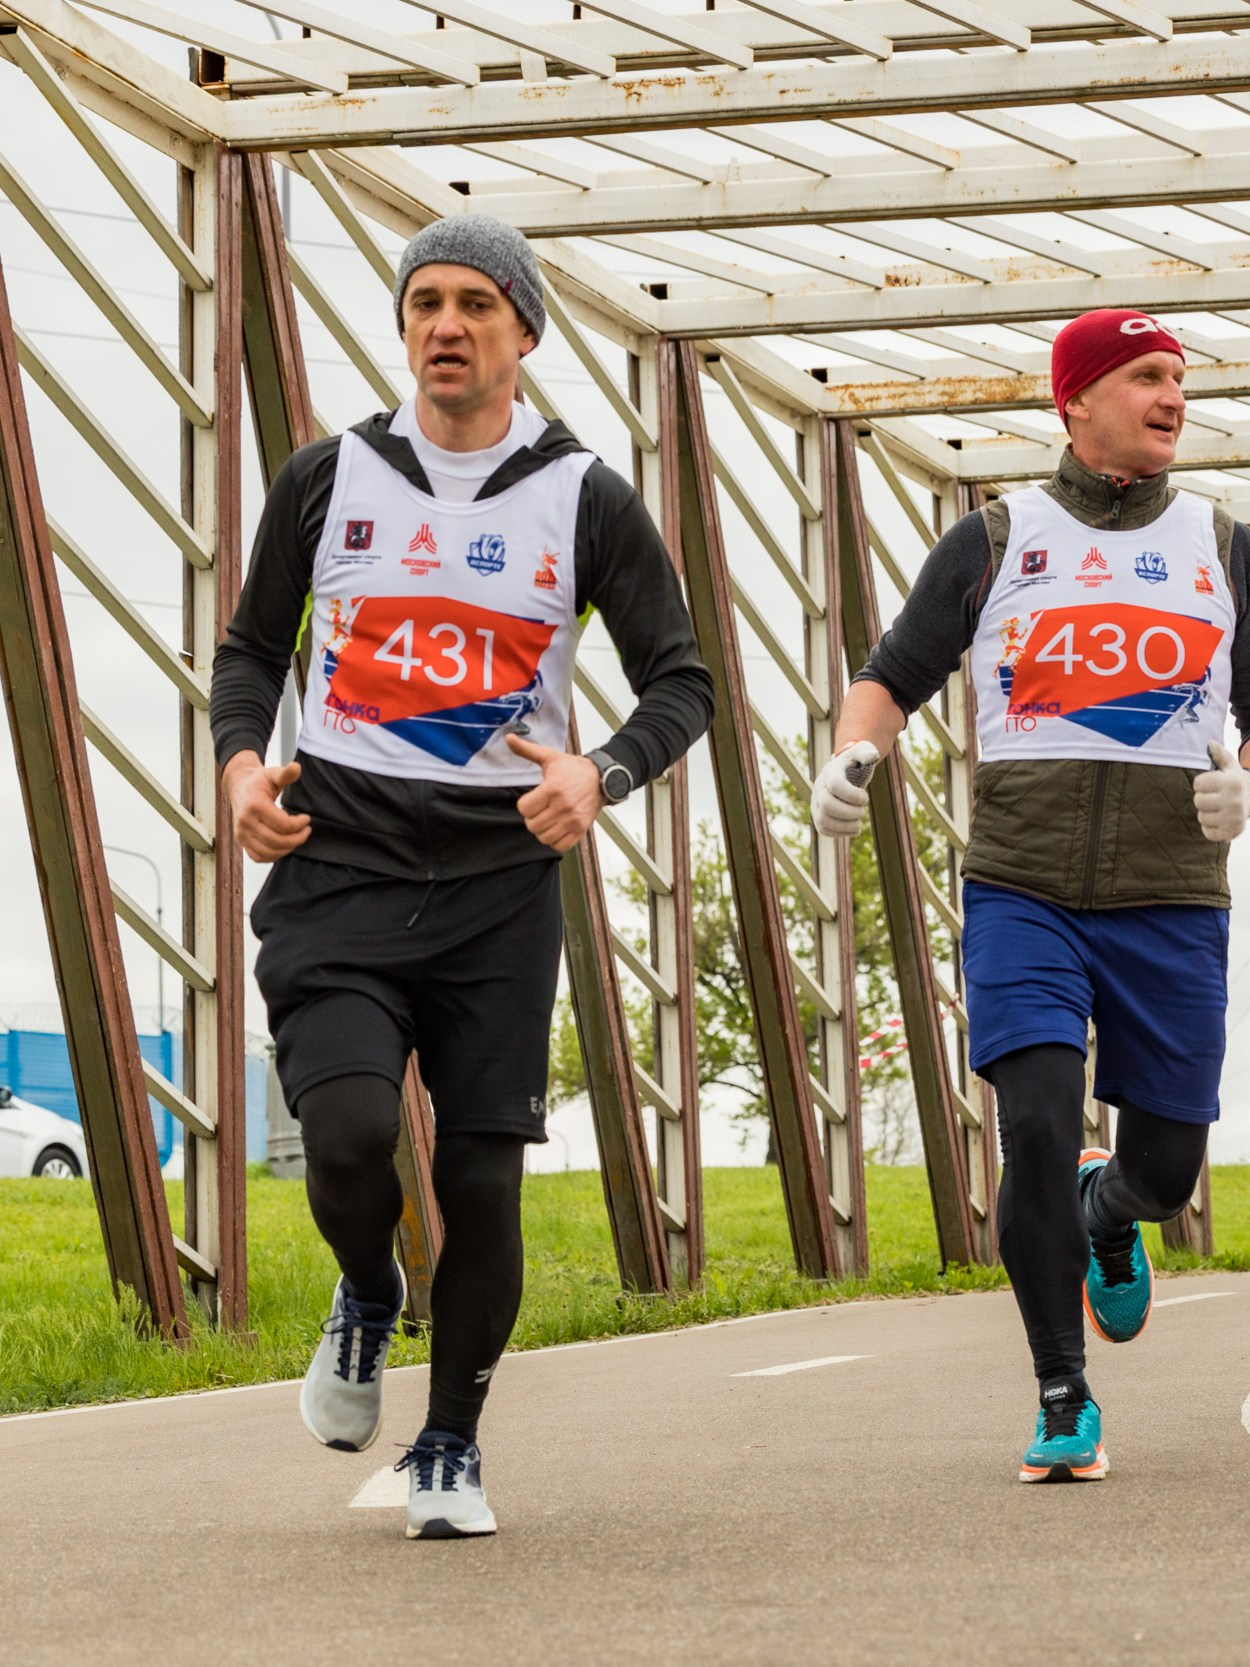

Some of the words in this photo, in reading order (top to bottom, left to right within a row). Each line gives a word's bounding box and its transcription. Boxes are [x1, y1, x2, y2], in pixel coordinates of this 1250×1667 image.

[373, 619, 495, 691] 431
[1035, 622, 1186, 681] 430
[324, 708, 356, 735] ГТО
[1006, 716, 1037, 734] ГТО
[1044, 1386, 1068, 1399] HOKA
